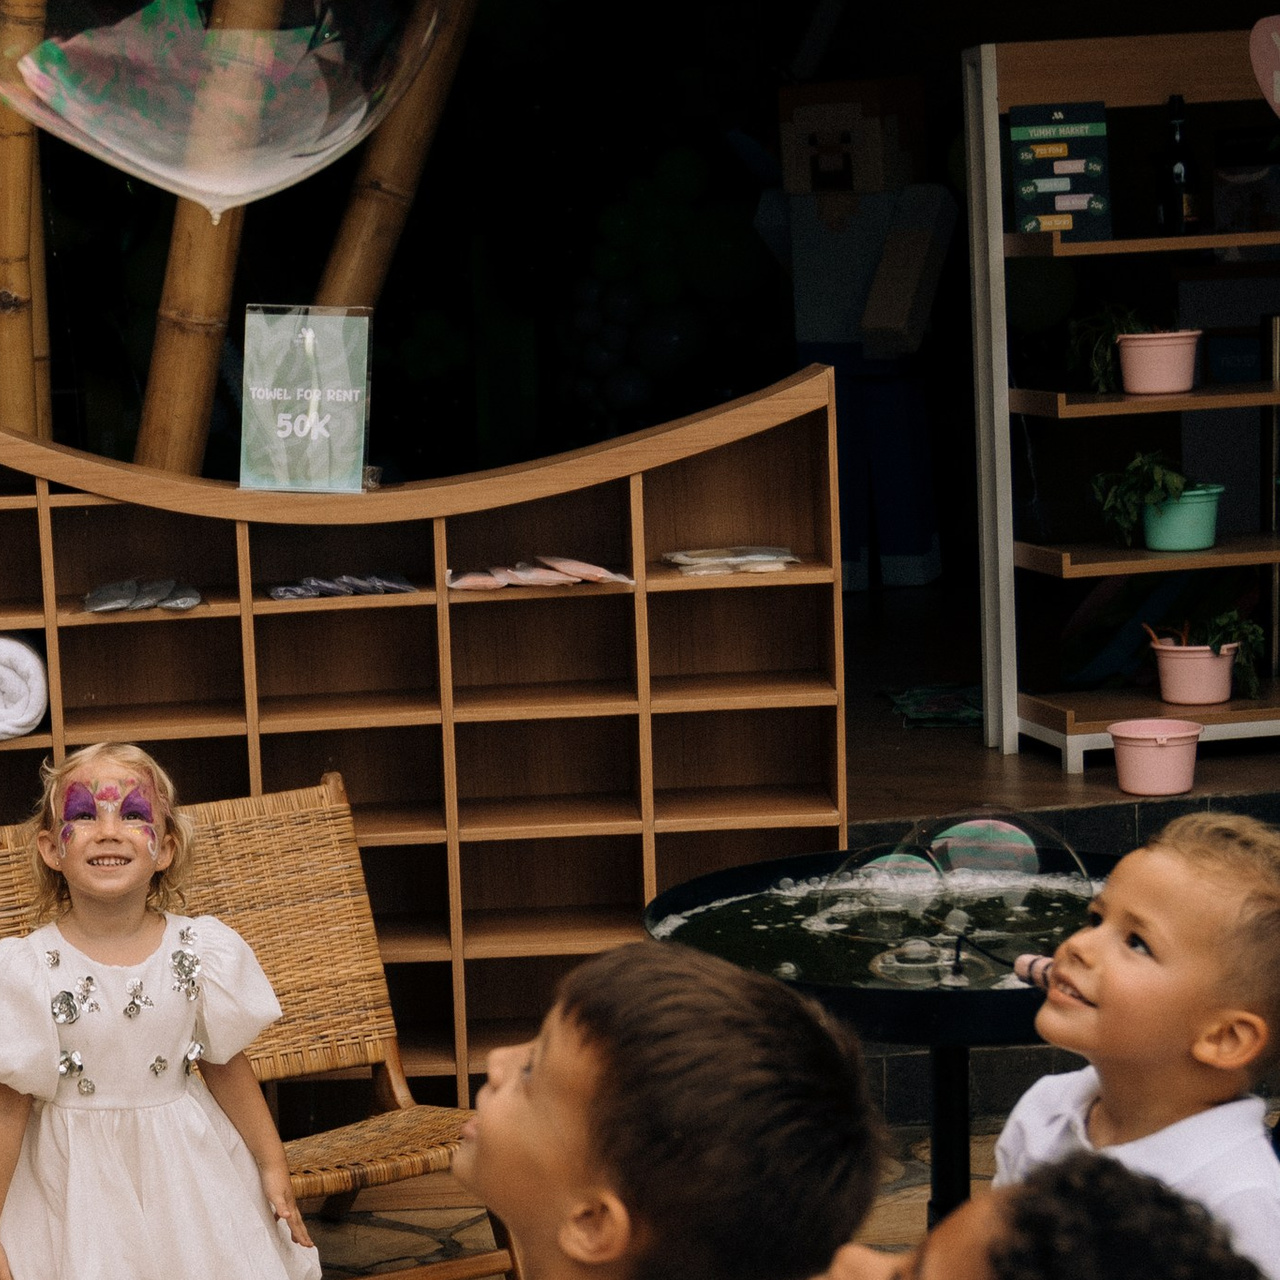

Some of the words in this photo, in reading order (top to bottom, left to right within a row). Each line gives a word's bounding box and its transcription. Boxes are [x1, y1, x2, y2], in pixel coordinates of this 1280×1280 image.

[1029, 127, 1056, 138] YUMMY
[1059, 125, 1089, 136] MARKET
[250, 387, 291, 400] TOWEL
[296, 387, 322, 401] FOR
[326, 389, 360, 402] RENT
[276, 410, 332, 441] 50K
